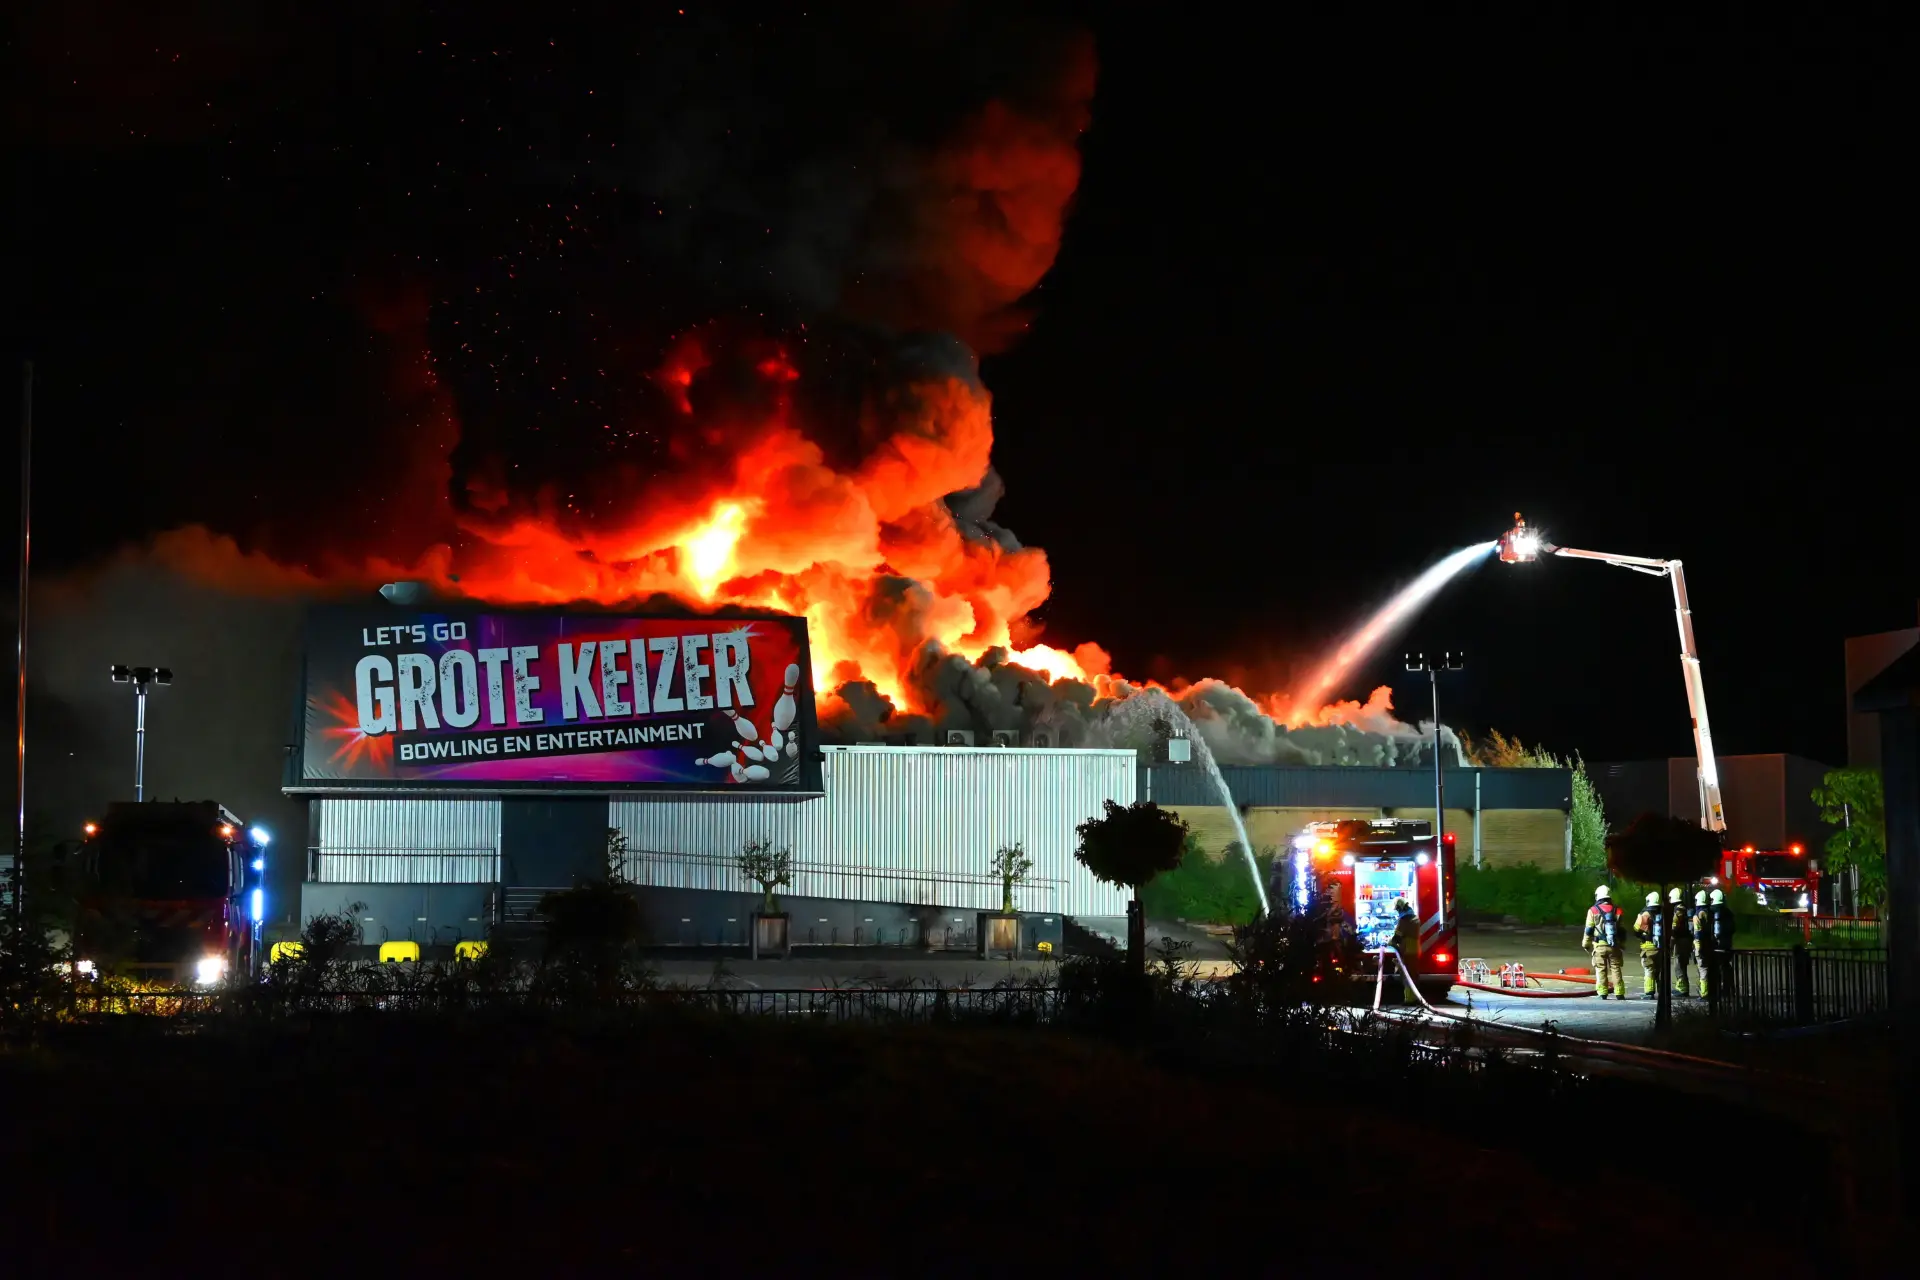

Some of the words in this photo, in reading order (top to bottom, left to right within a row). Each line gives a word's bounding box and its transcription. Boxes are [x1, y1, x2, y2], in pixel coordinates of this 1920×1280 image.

[363, 625, 426, 646] LET'S
[433, 622, 467, 641] GO
[355, 645, 544, 735] GROTE
[558, 632, 755, 720] KEIZER
[400, 738, 498, 761] BOWLING
[504, 735, 531, 753] EN
[536, 723, 705, 752] ENTERTAINMENT
